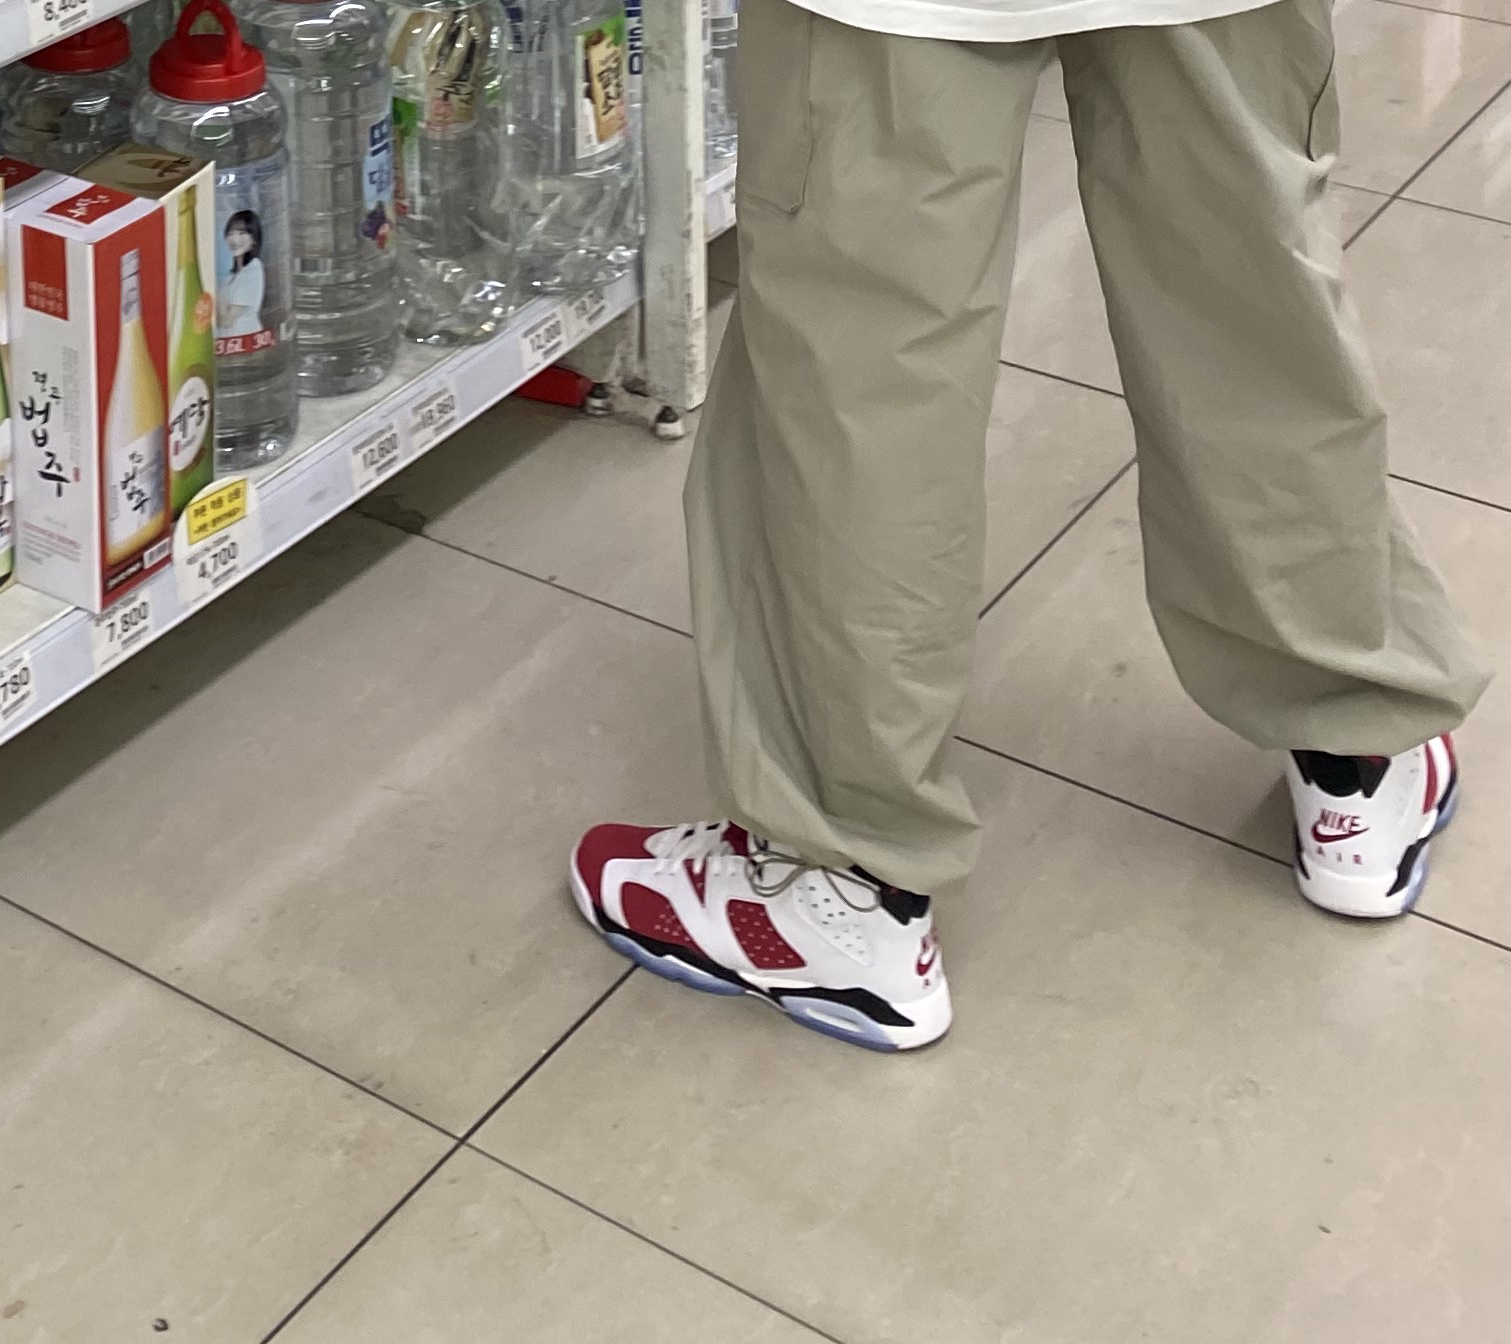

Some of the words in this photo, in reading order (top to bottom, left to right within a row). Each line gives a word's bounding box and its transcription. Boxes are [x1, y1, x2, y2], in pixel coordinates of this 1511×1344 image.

[197, 542, 240, 581] 4,700
[105, 603, 149, 643] 7,800
[1320, 808, 1360, 832] NIKE
